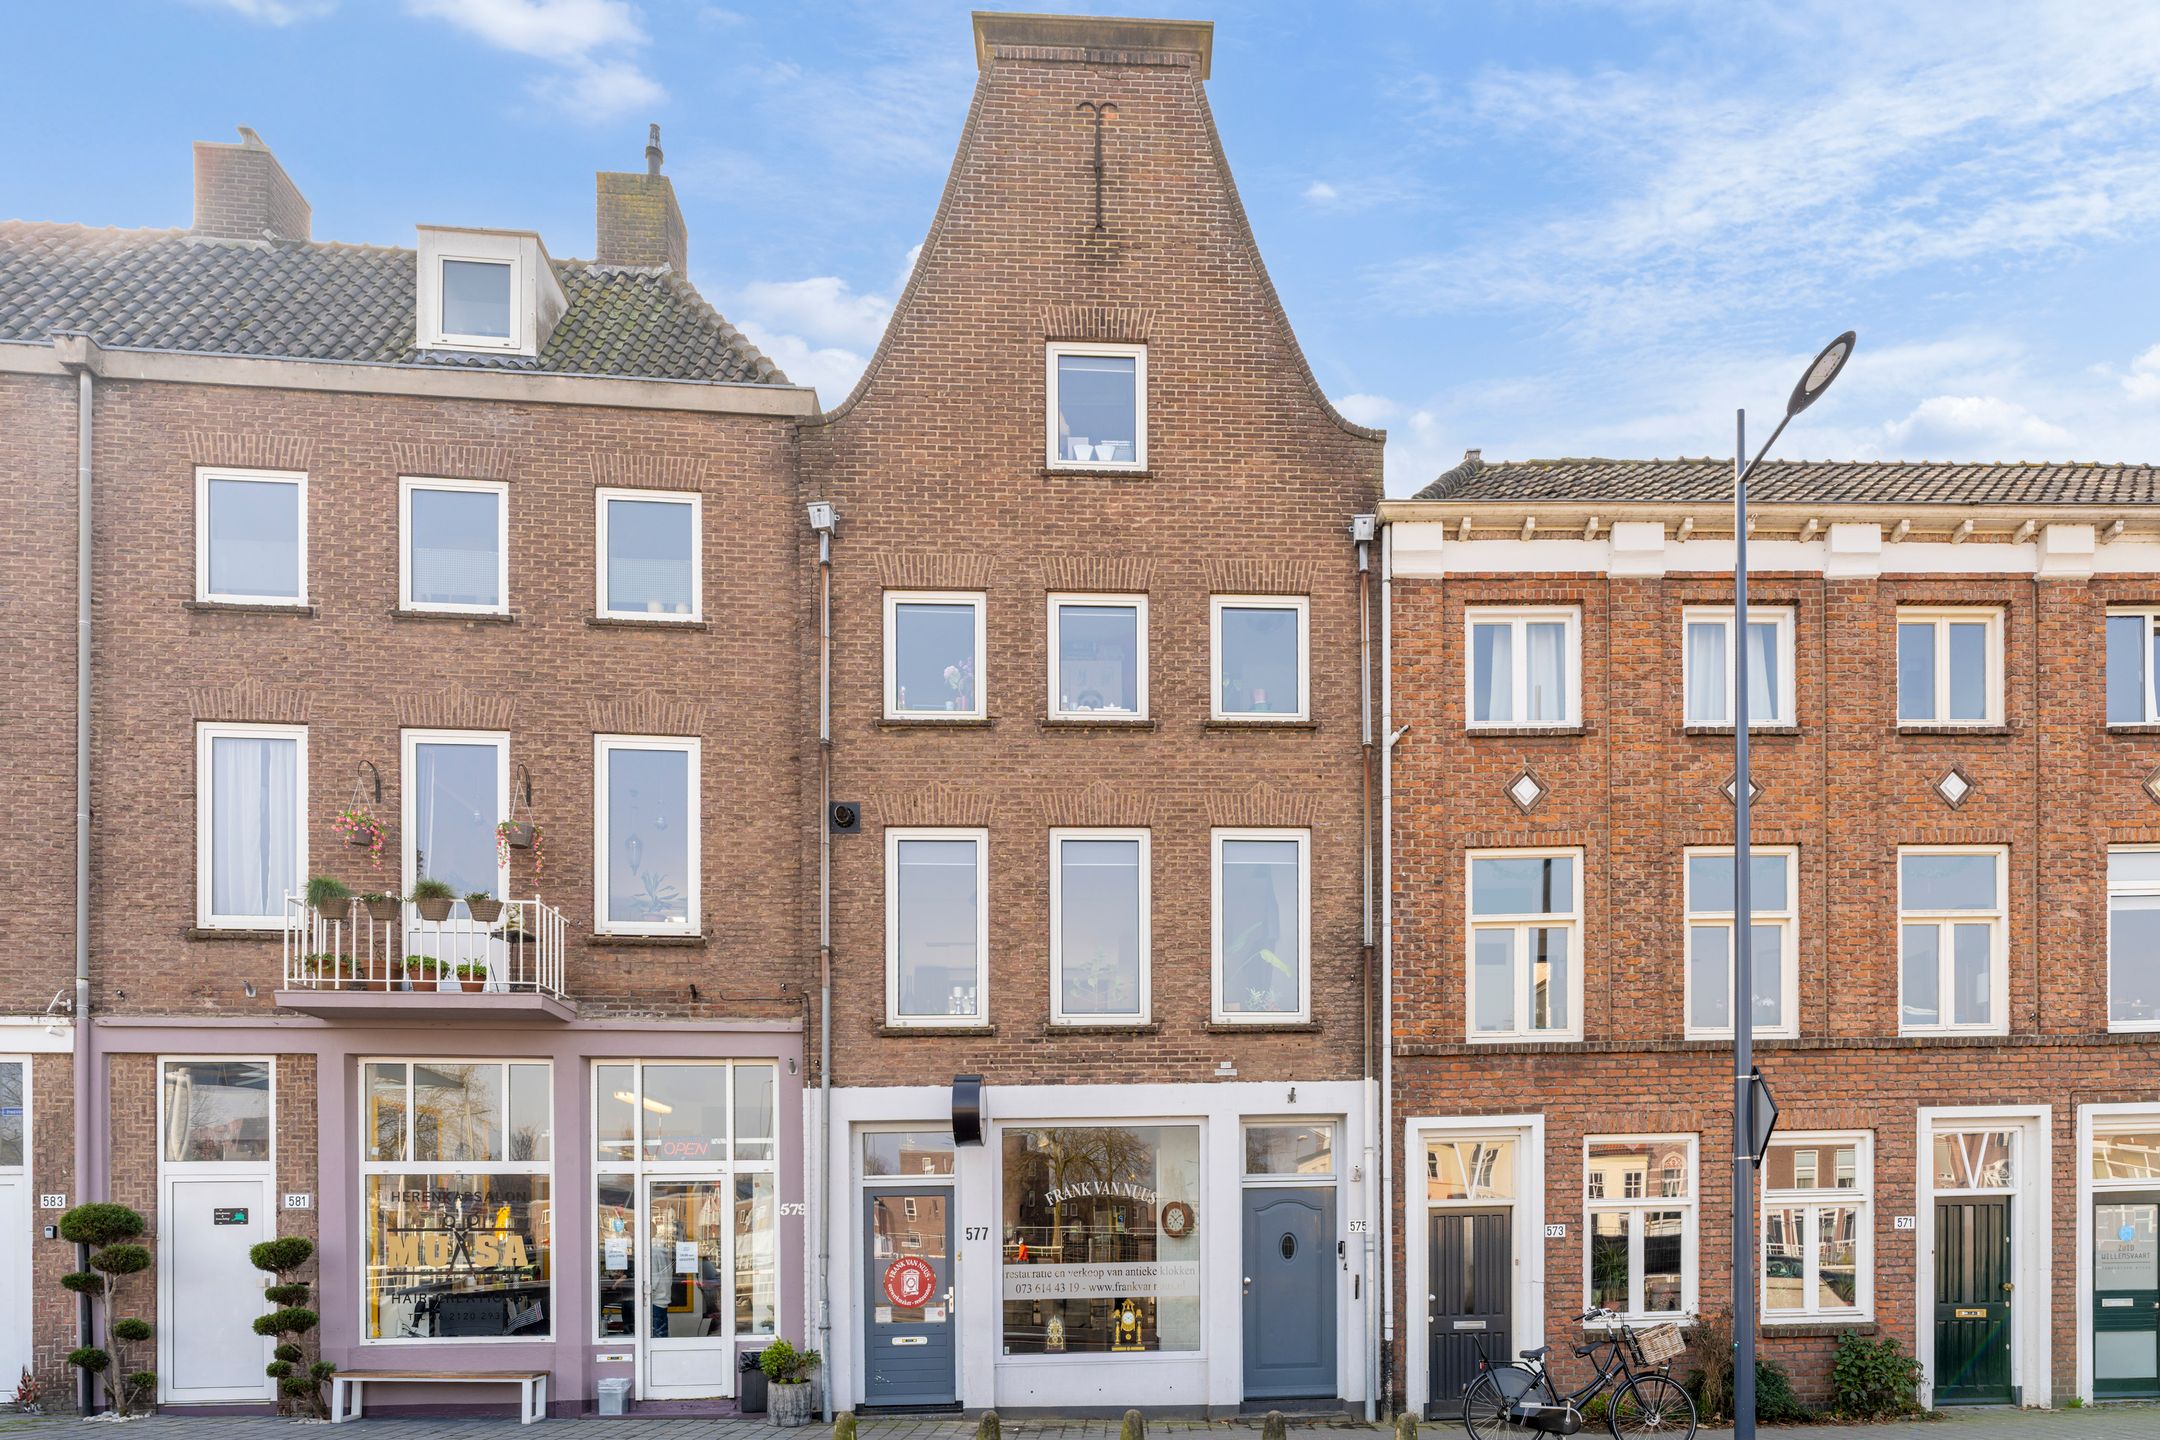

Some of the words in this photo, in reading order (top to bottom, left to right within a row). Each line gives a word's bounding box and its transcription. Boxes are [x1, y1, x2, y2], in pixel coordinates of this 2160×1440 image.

[663, 1142, 709, 1155] OPEN
[1044, 1181, 1090, 1206] FRANK
[1094, 1181, 1120, 1196] VAN
[1124, 1183, 1159, 1205] NUUS
[43, 1196, 63, 1206] 583
[288, 1196, 306, 1206] 581
[780, 1203, 805, 1216] 579
[1350, 1220, 1366, 1231] 575
[1897, 1217, 1912, 1227] 571
[966, 1227, 989, 1241] 577
[1546, 1225, 1564, 1236] 573
[889, 1260, 906, 1278] FRANK
[1005, 1269, 1052, 1279] restauratie
[1068, 1268, 1104, 1279] verkoop
[1125, 1267, 1157, 1276] antieke
[1160, 1266, 1195, 1275] klokken
[1015, 1283, 1032, 1294] 073
[1035, 1283, 1051, 1293] 614
[1054, 1283, 1066, 1293] 43
[1069, 1282, 1080, 1293] 19
[391, 1293, 427, 1304] HAIR
[436, 1292, 526, 1304] CREATIOS
